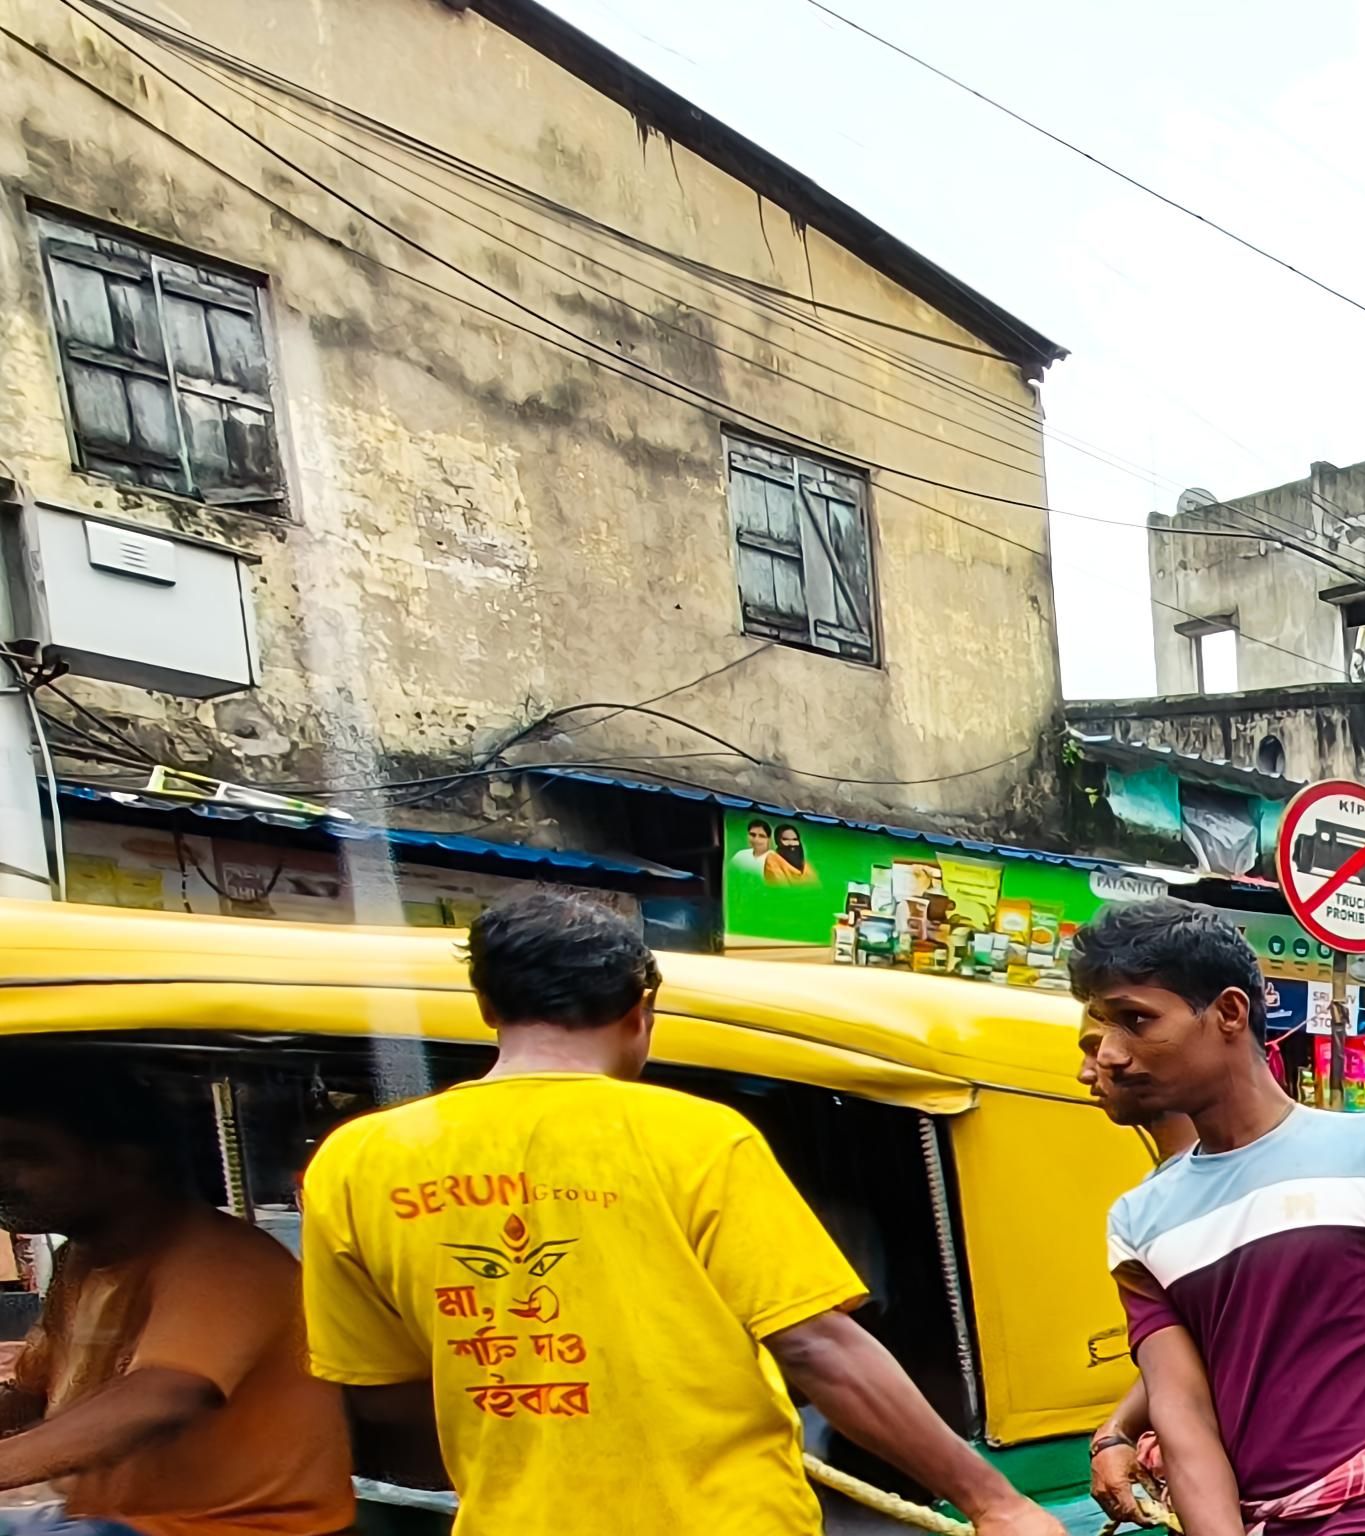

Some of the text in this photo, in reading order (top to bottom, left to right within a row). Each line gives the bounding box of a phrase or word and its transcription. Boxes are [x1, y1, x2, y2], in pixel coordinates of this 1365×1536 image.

[390, 1171, 620, 1220] SERUM Group
[529, 1333, 587, 1365] দাও
